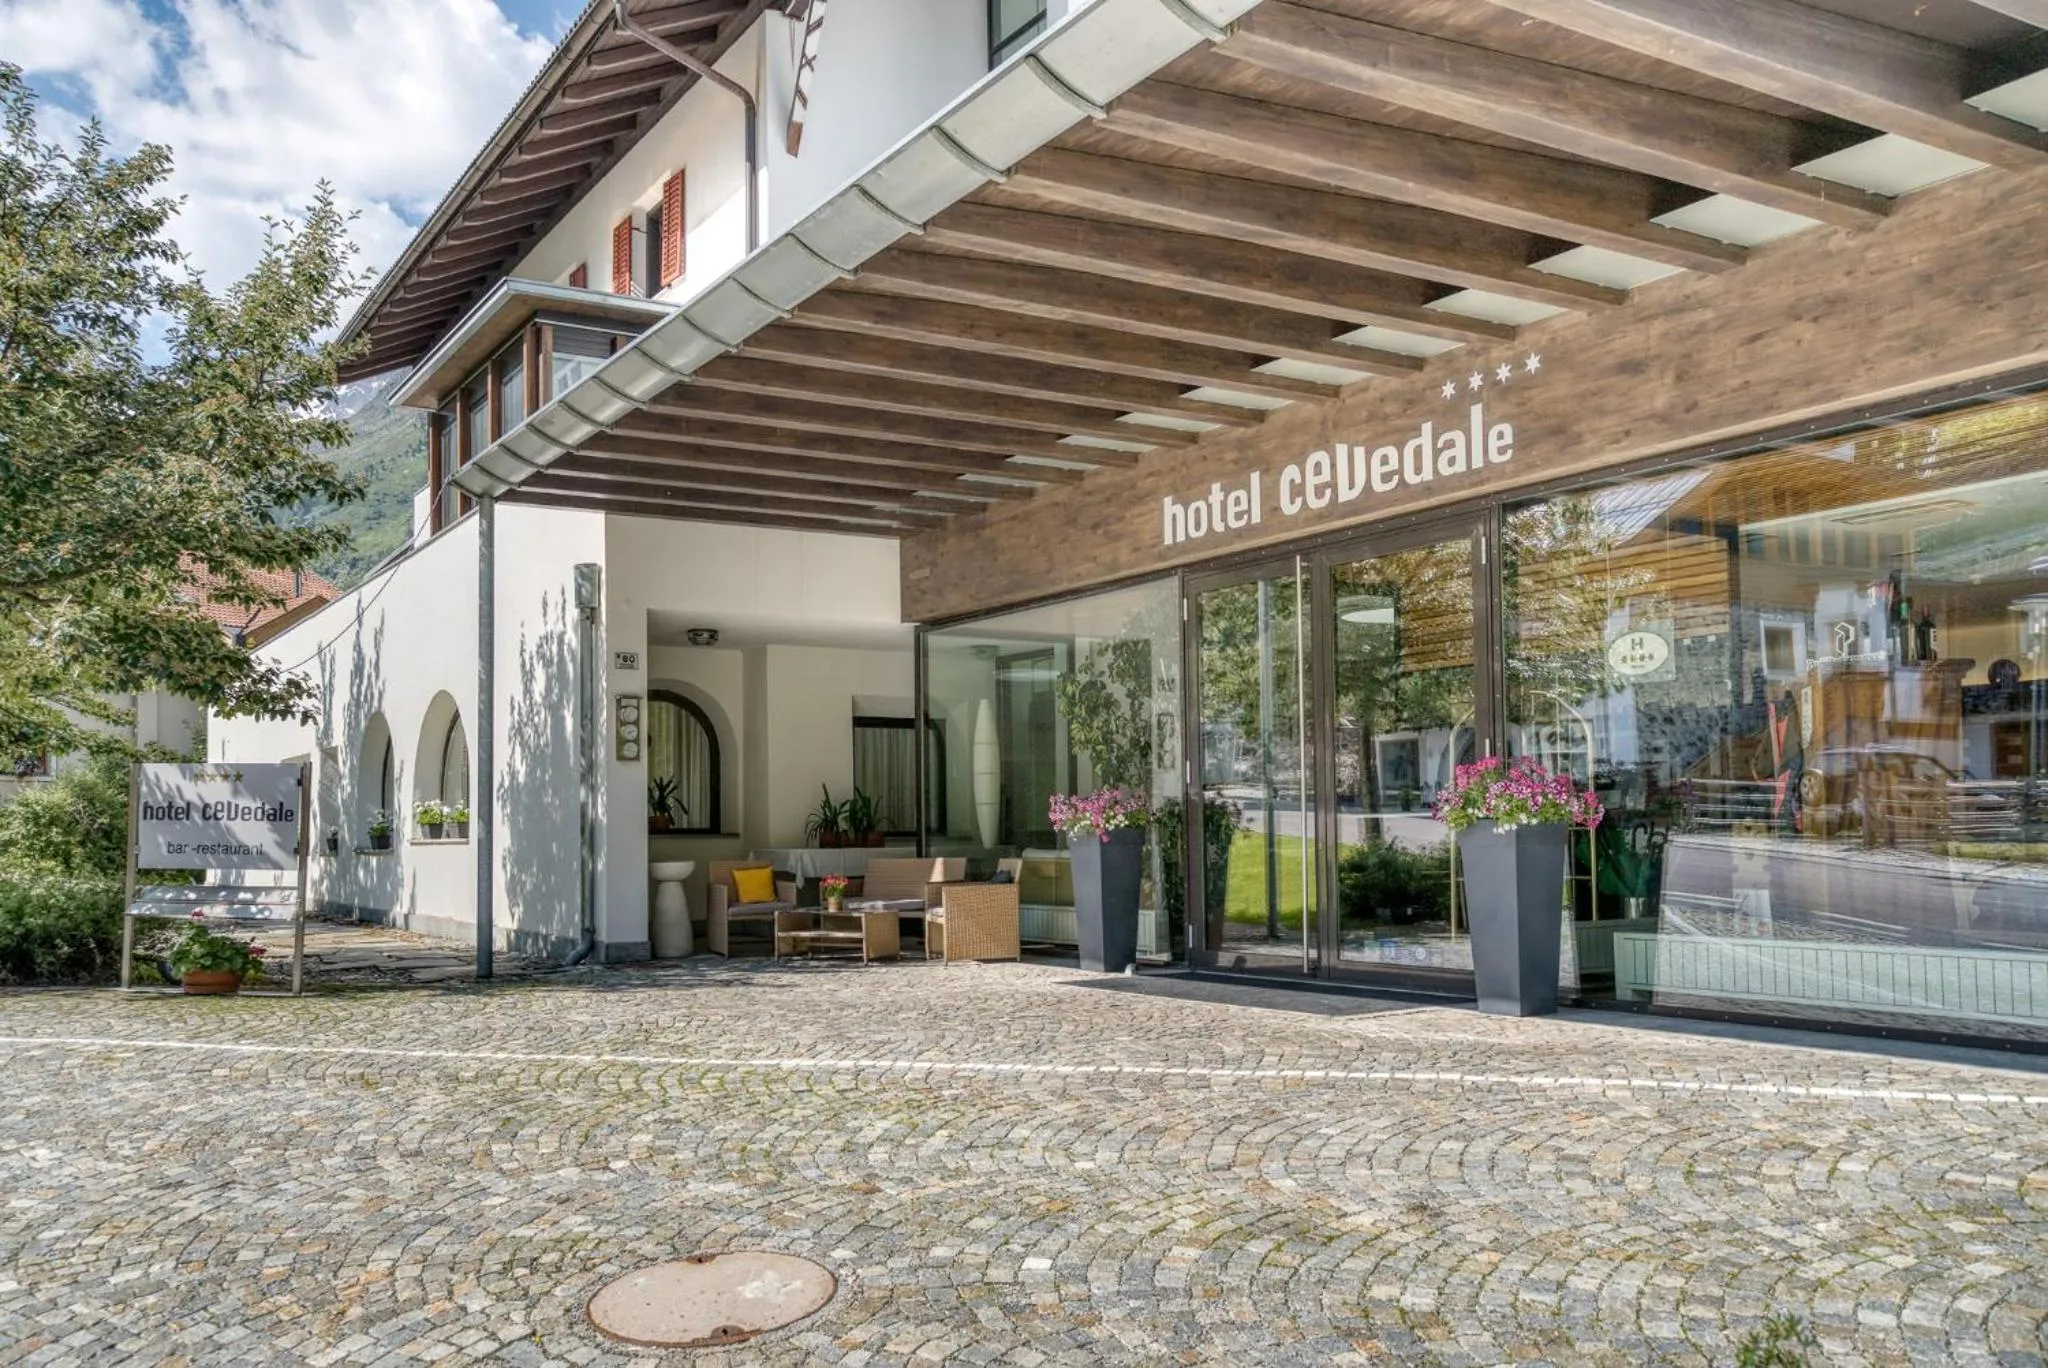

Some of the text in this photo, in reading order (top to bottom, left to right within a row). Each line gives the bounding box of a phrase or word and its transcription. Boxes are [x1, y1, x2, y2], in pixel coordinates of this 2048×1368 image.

[1163, 402, 1515, 545] hotel cevedale
[1631, 637, 1645, 651] H
[143, 800, 294, 822] hotel cevedale
